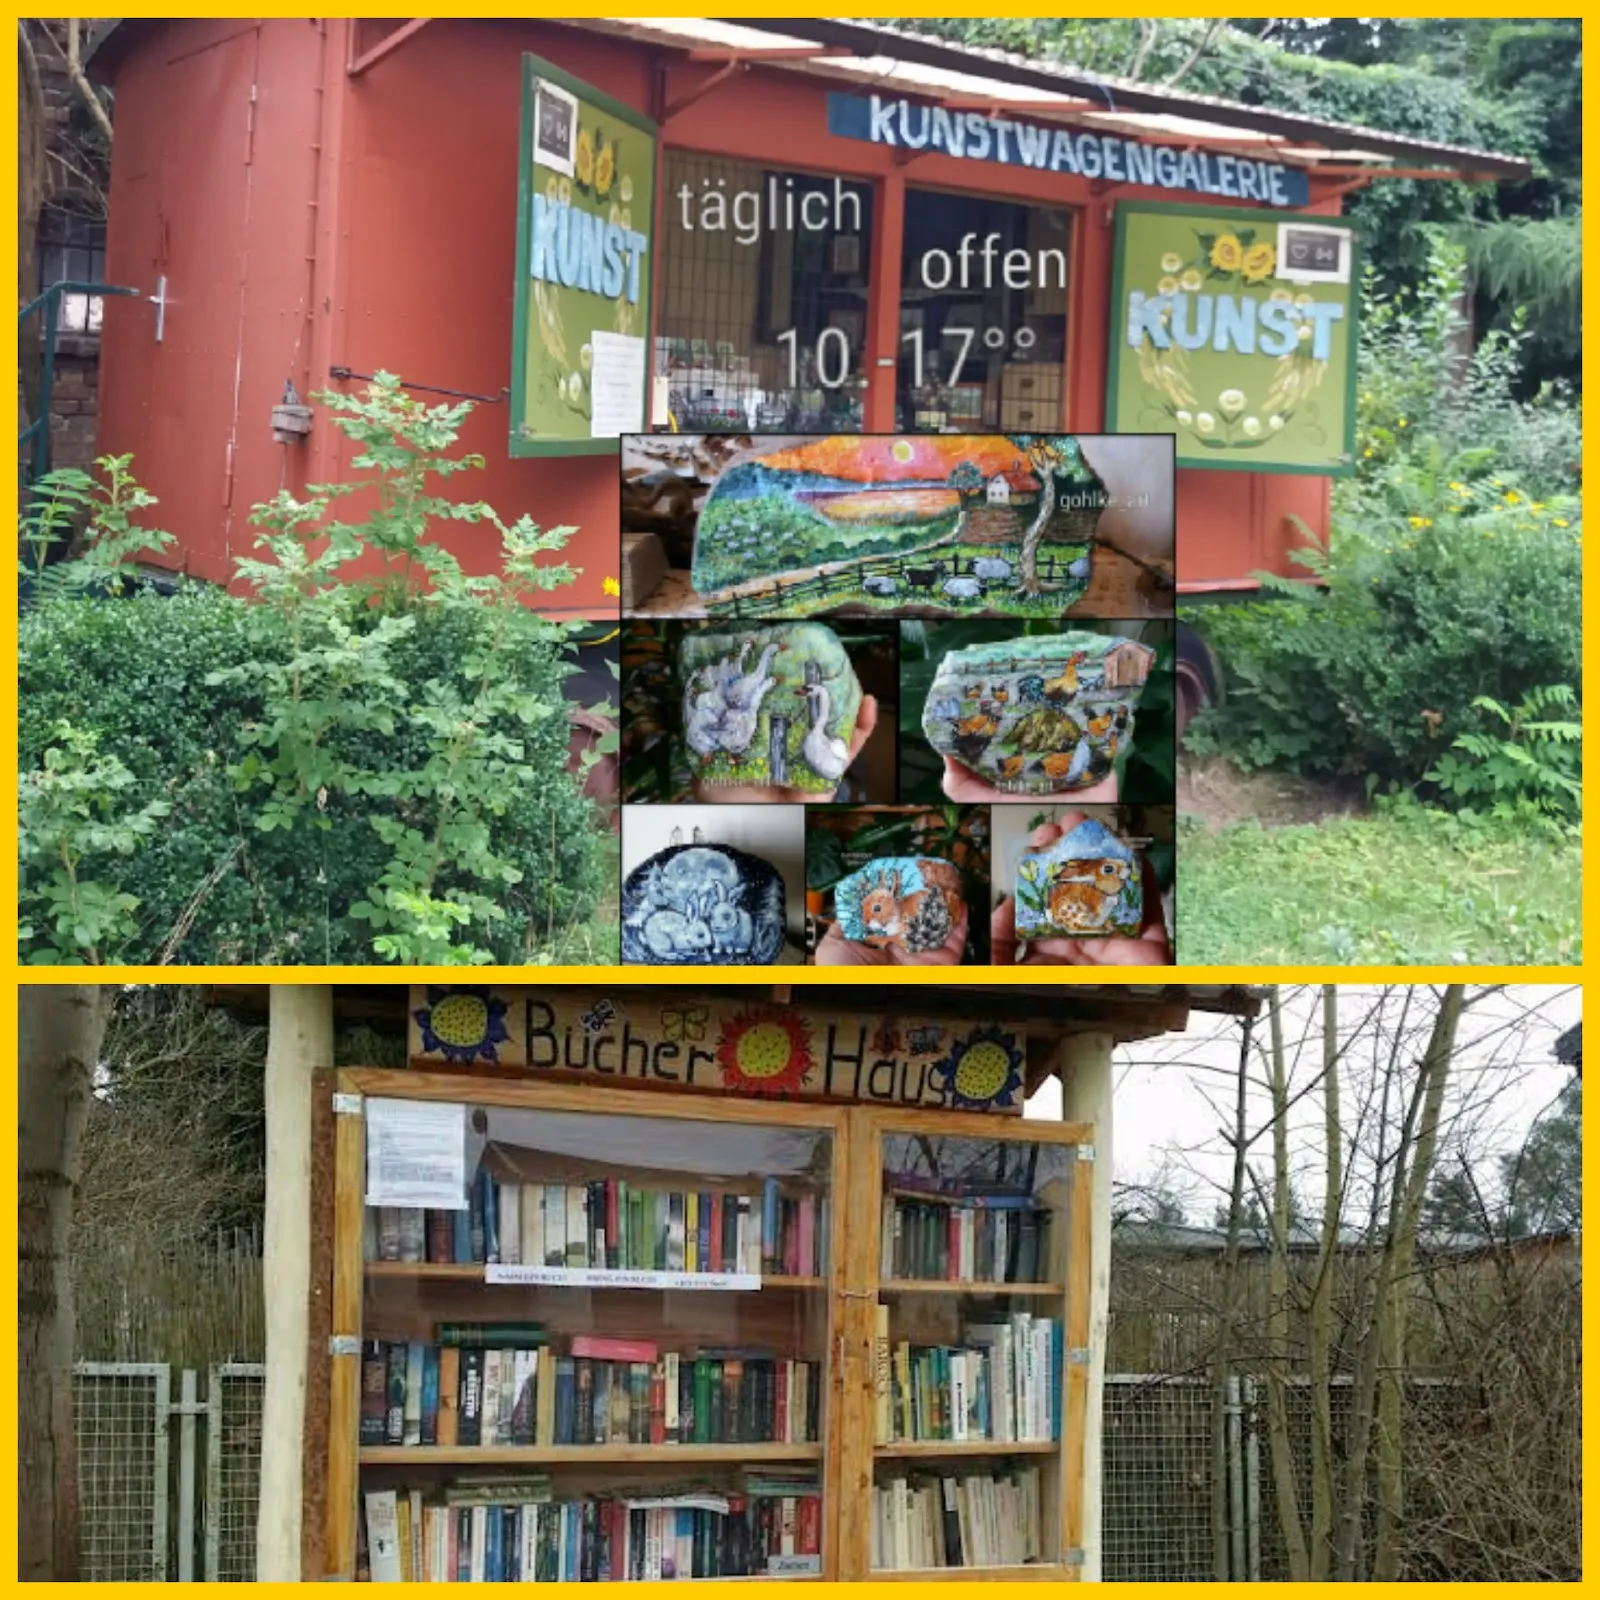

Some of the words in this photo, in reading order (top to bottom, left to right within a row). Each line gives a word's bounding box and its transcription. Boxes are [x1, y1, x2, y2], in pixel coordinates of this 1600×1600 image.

[869, 95, 1289, 206] KUNSTWAGENGALERIE
[531, 192, 647, 305] KUNST
[1127, 289, 1344, 361] KUNST
[524, 998, 716, 1085] Bücher
[823, 1022, 948, 1106] Haus
